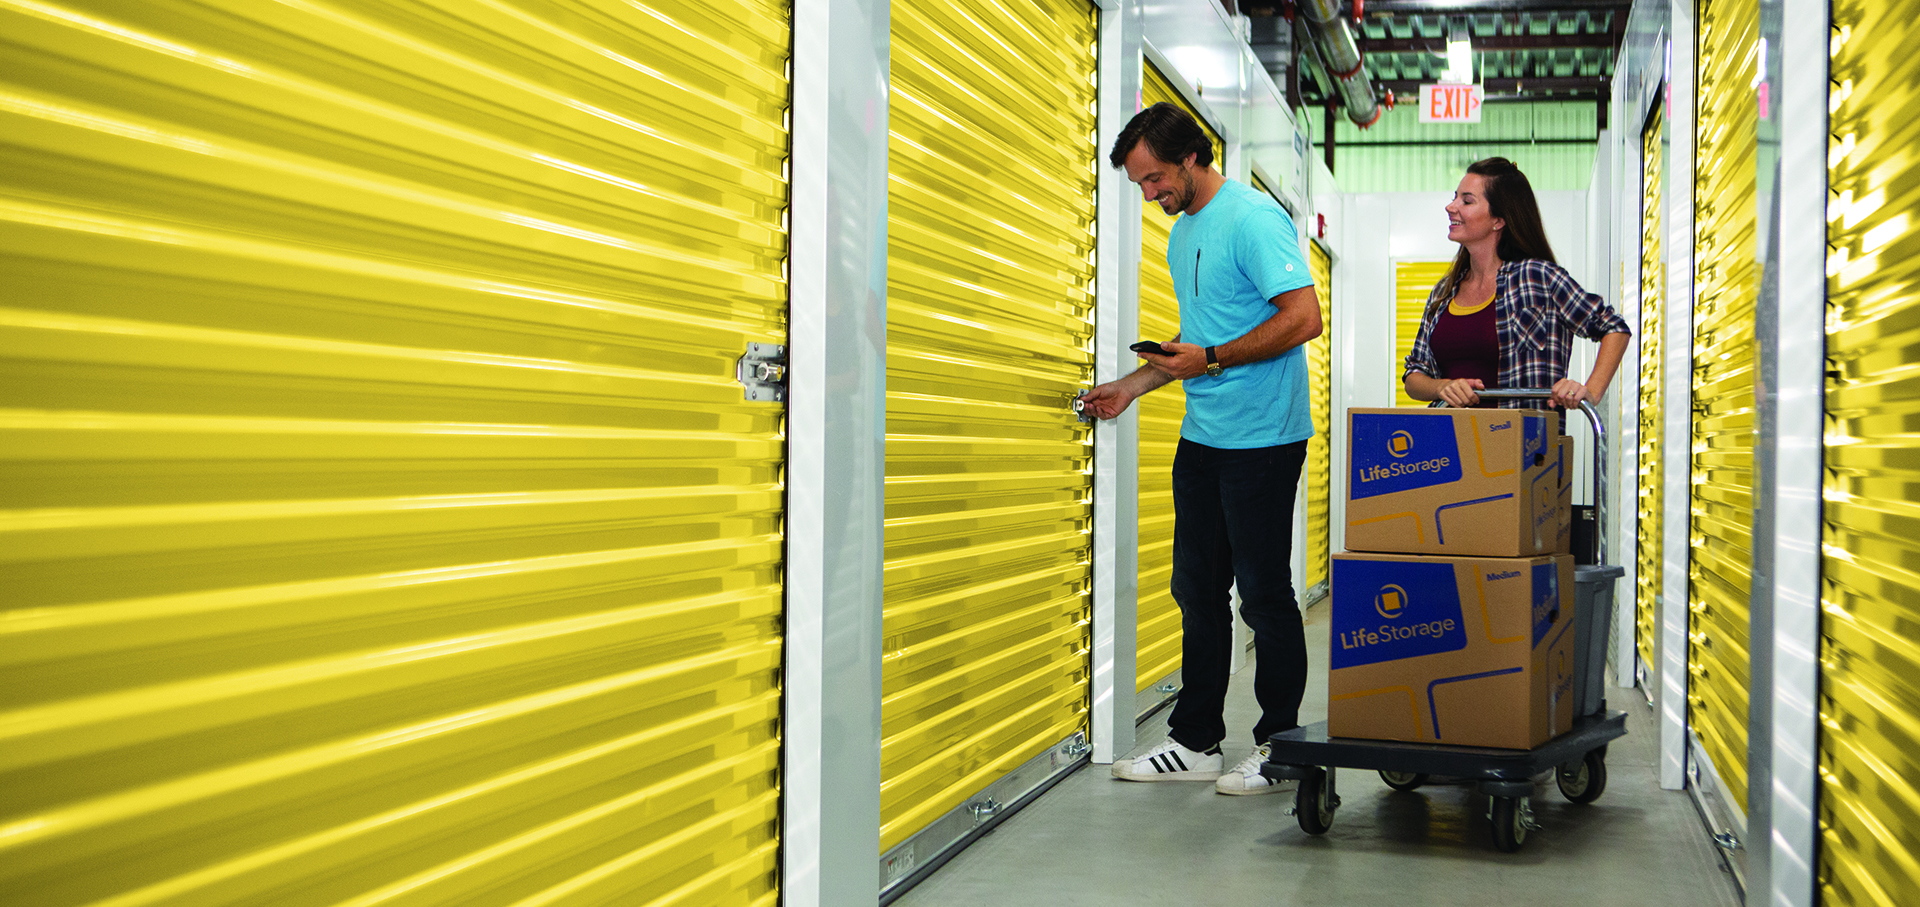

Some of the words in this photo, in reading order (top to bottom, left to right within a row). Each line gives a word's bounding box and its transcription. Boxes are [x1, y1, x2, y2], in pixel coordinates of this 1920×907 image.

[1431, 86, 1473, 118] EXIT
[1489, 420, 1512, 432] Small
[1359, 456, 1450, 483] LifeStorage
[1486, 570, 1521, 581] Medium
[1340, 618, 1455, 650] LifeStorage
